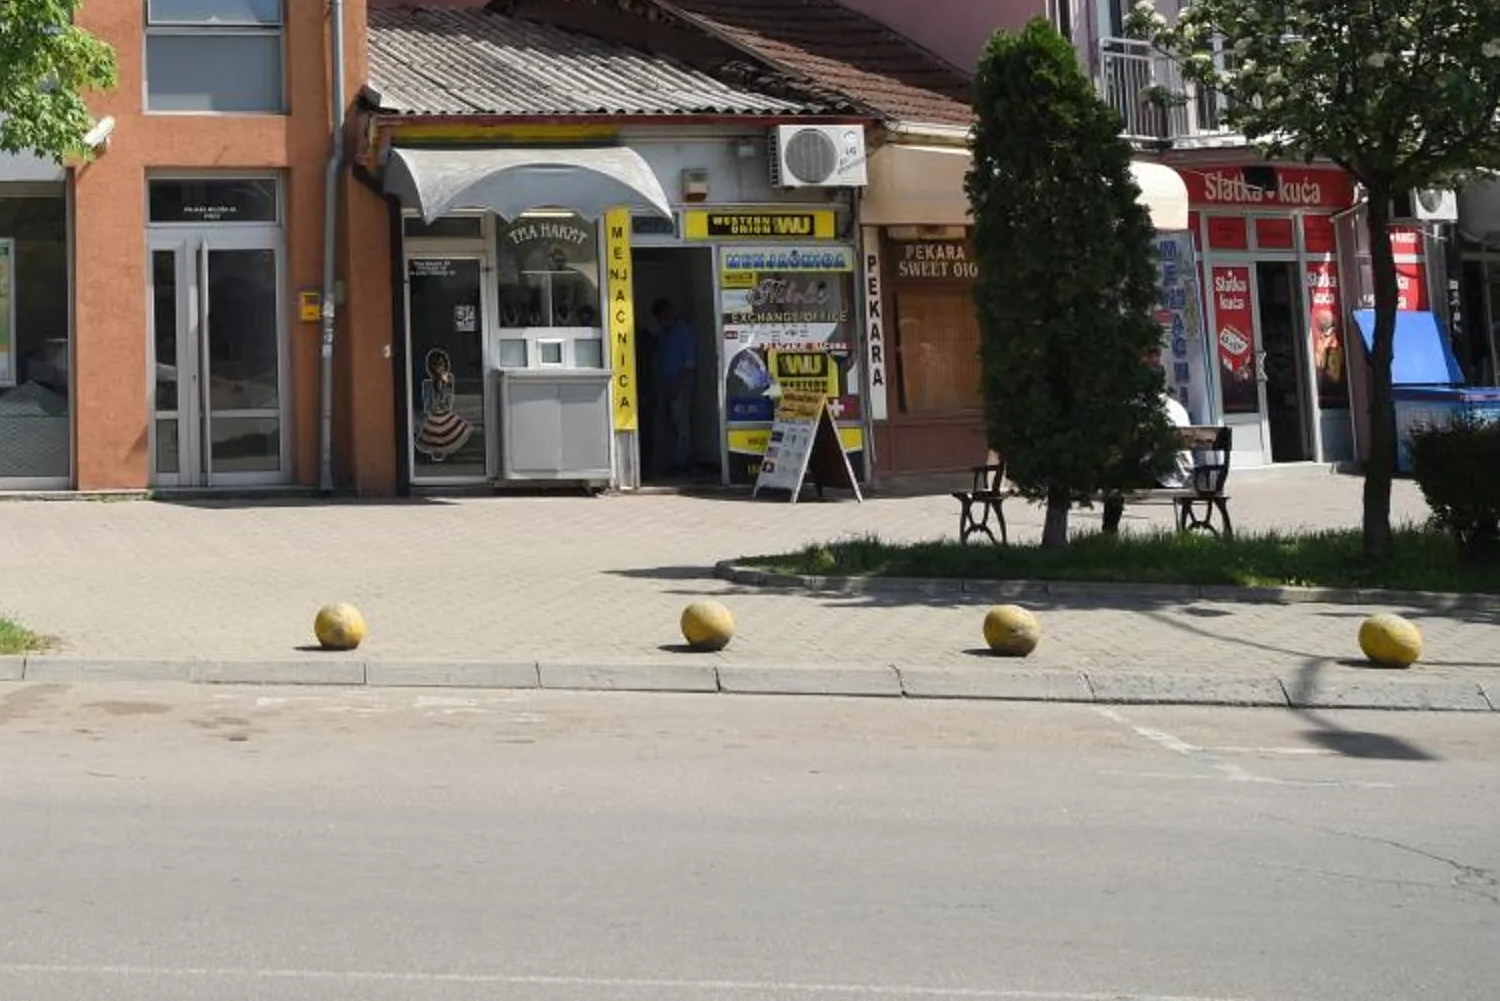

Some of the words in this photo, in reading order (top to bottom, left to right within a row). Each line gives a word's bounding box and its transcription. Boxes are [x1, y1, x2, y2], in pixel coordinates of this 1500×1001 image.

[1203, 171, 1263, 202] Slatka
[1278, 174, 1321, 204] kuća
[712, 216, 771, 226] WESTERN
[731, 222, 771, 234] UNION
[907, 245, 965, 260] PEKARA
[899, 261, 947, 277] SWEET
[867, 255, 884, 386] PEKARA
